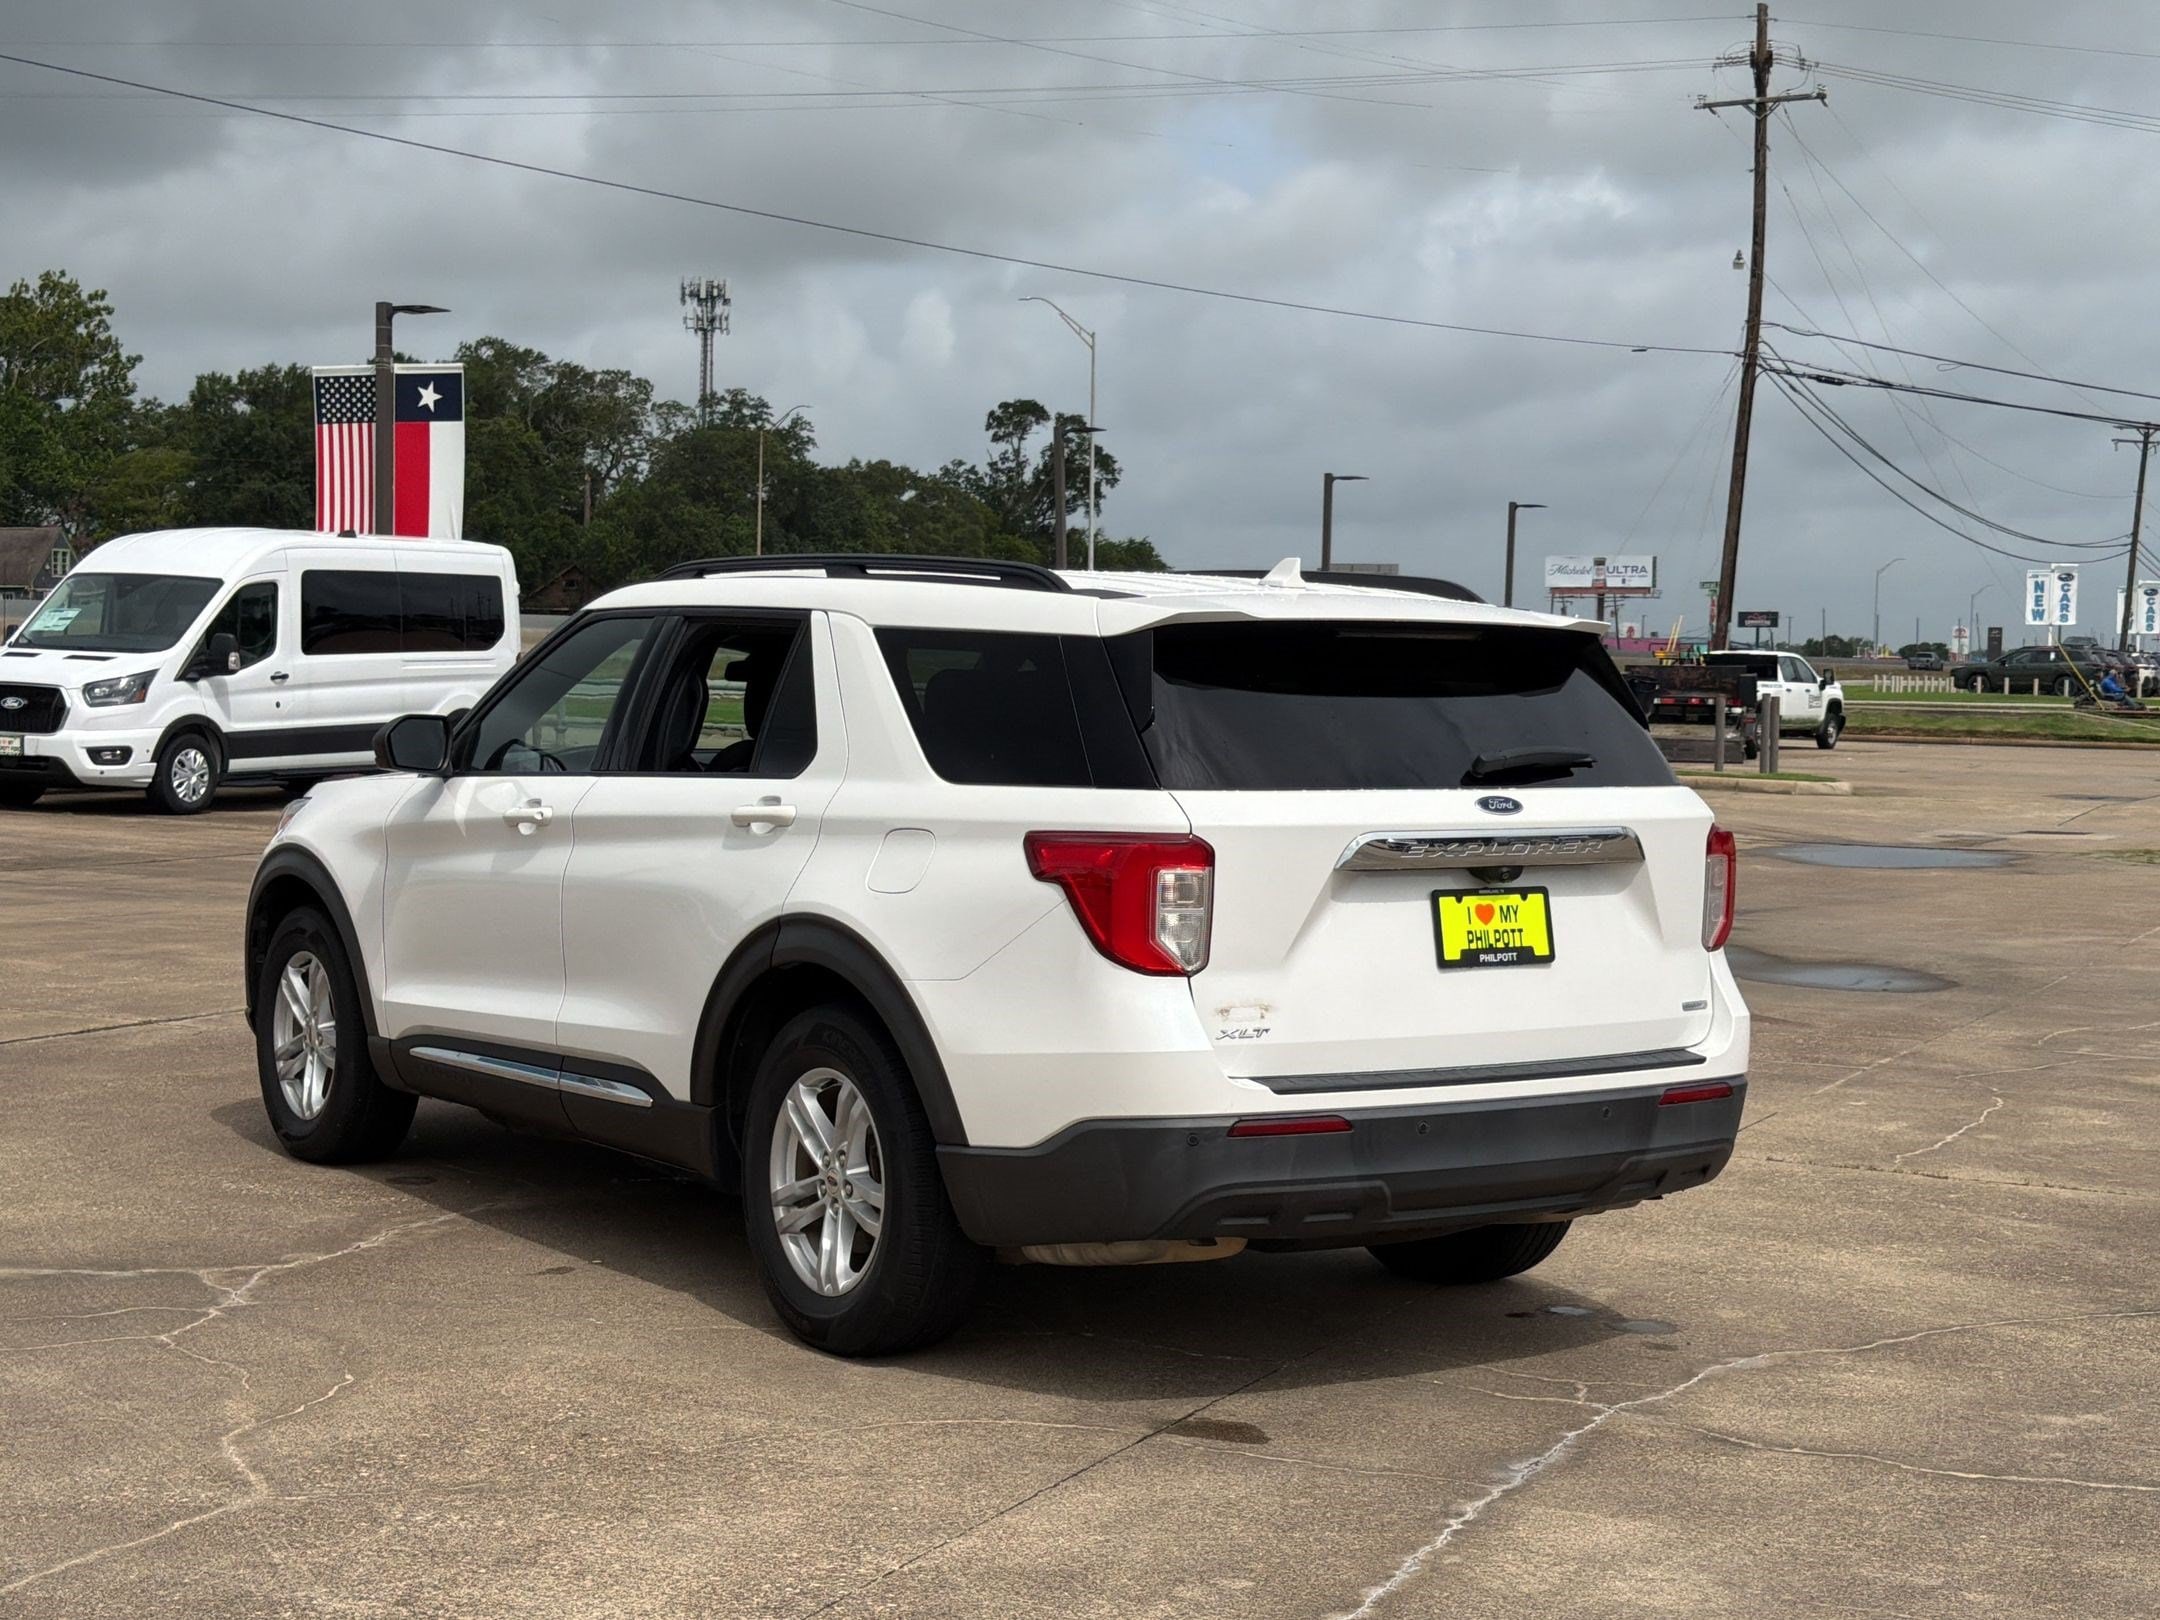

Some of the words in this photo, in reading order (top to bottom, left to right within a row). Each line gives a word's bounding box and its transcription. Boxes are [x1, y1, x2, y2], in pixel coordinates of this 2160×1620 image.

[1606, 565, 1648, 574] ULTRA
[2031, 580, 2045, 621] NEW
[2059, 583, 2071, 623] CARS
[2145, 597, 2156, 632] CARS
[1488, 798, 1515, 810] Ford
[1400, 839, 1604, 859] EXPLORER
[1467, 906, 1472, 925] I
[1499, 904, 1519, 923] MY
[1466, 928, 1524, 950] PHILPOTT
[1479, 952, 1518, 963] PHILPOTT
[1215, 1027, 1271, 1040] XLT
